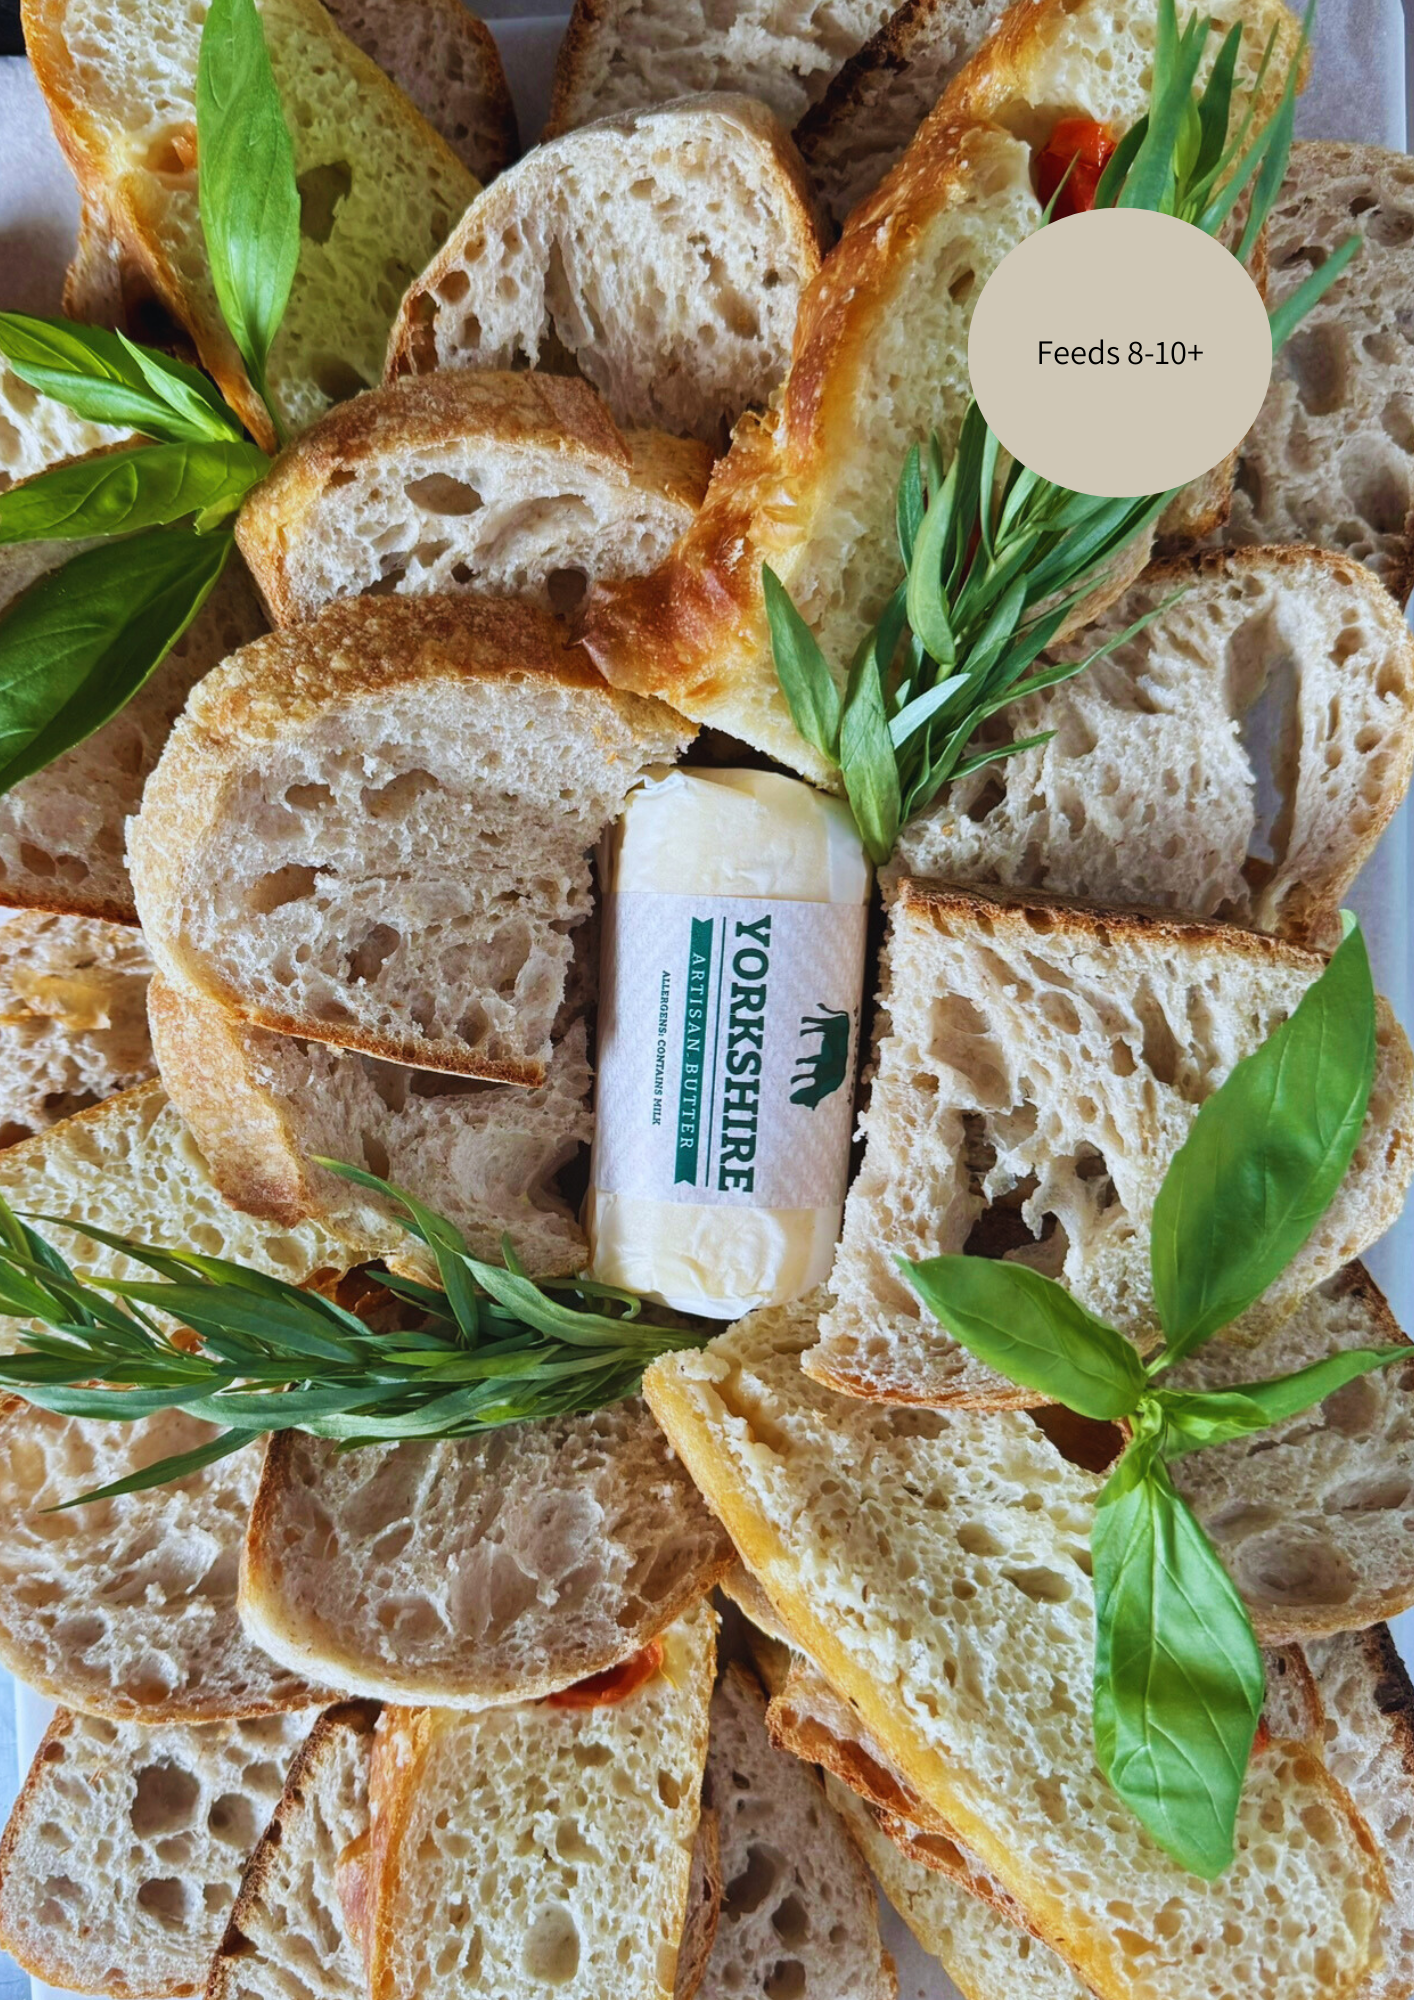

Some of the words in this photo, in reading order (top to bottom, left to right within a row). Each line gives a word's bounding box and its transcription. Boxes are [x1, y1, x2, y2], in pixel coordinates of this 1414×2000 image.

[658, 970, 671, 1037] ALLERGENS:
[687, 952, 706, 1052] ARTISAN
[654, 1039, 667, 1096] CONTAINS
[718, 914, 771, 1193] YORKSHIRE
[652, 1098, 662, 1125] MILK
[680, 1063, 699, 1148] BUTTER
